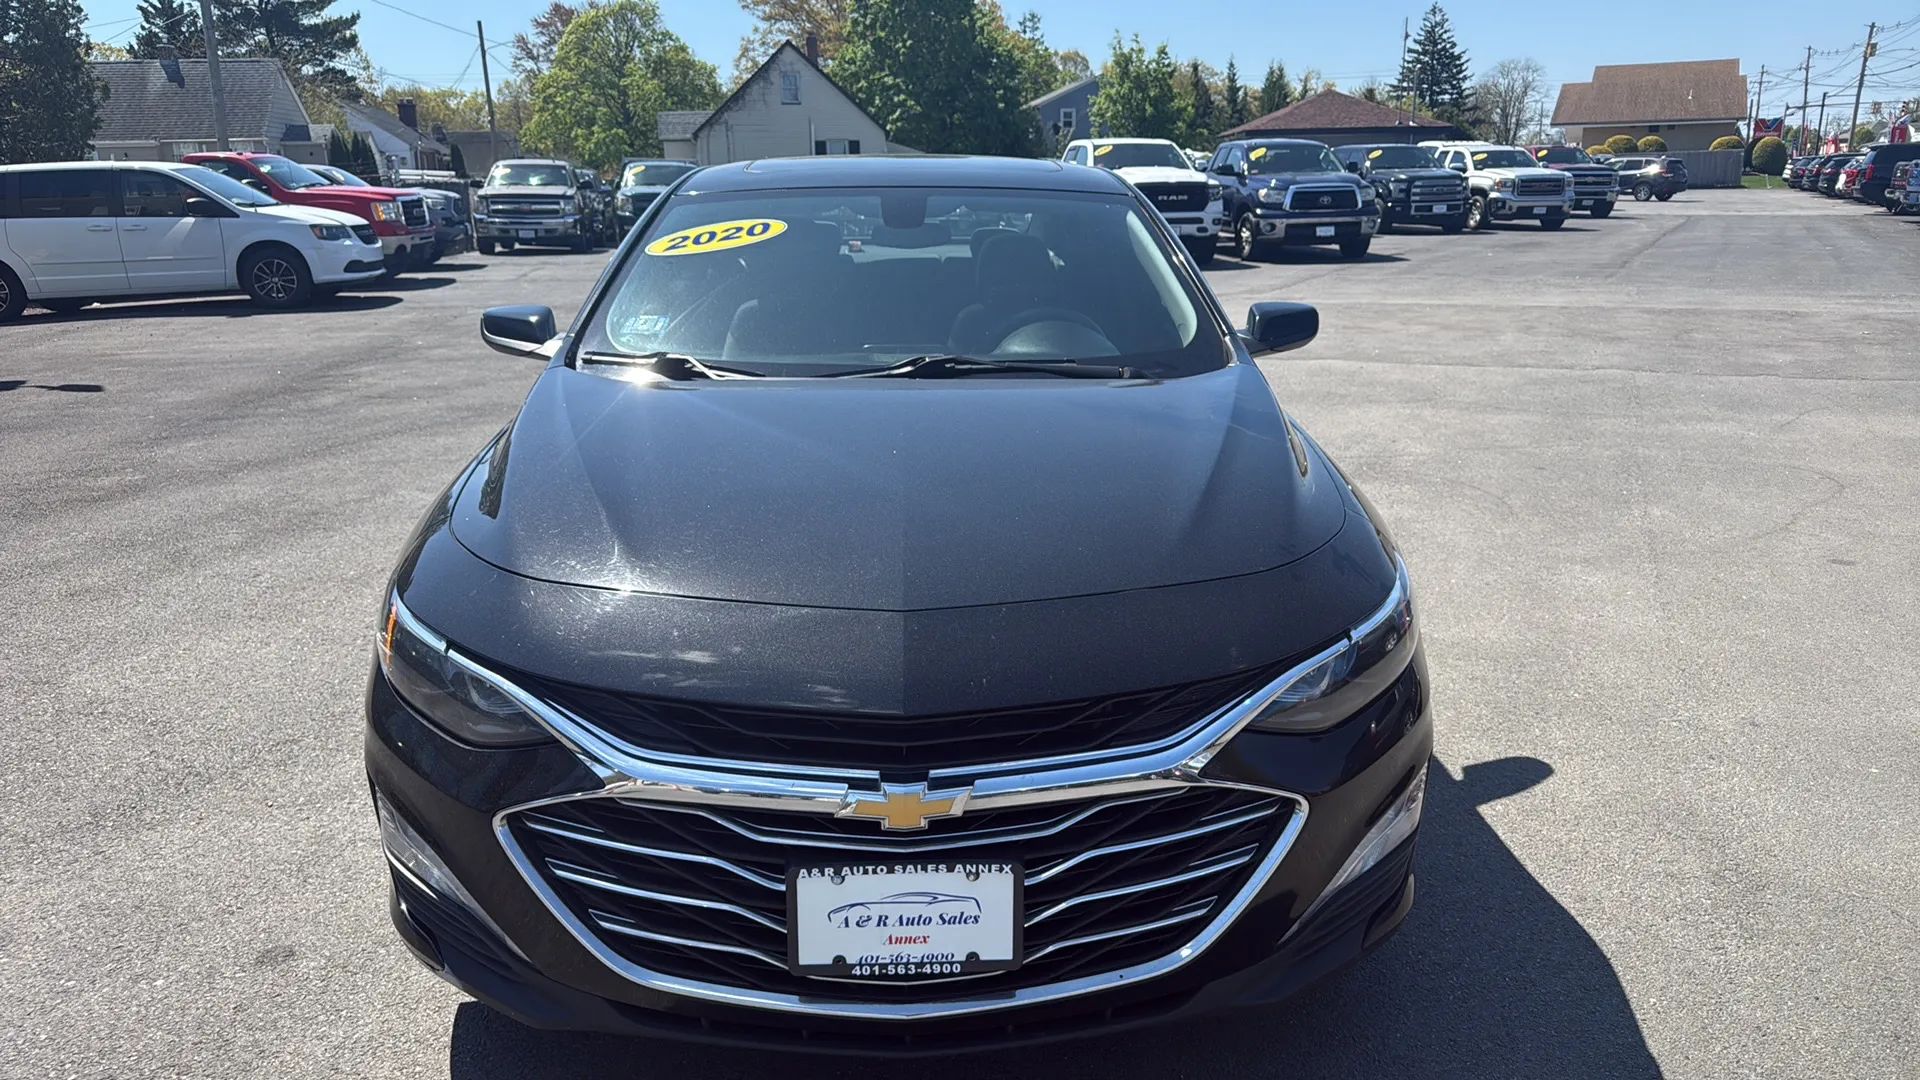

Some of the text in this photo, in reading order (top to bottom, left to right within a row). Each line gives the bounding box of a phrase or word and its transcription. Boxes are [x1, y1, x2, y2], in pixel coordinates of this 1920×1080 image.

[662, 222, 771, 252] 2020
[798, 864, 1013, 879] A&R AUTO SALES ANNEX
[838, 911, 981, 928] A & R Auto Sales
[883, 934, 930, 945] Annex
[856, 951, 955, 964] 401-563-4900
[852, 964, 960, 976] 401-563-4900
